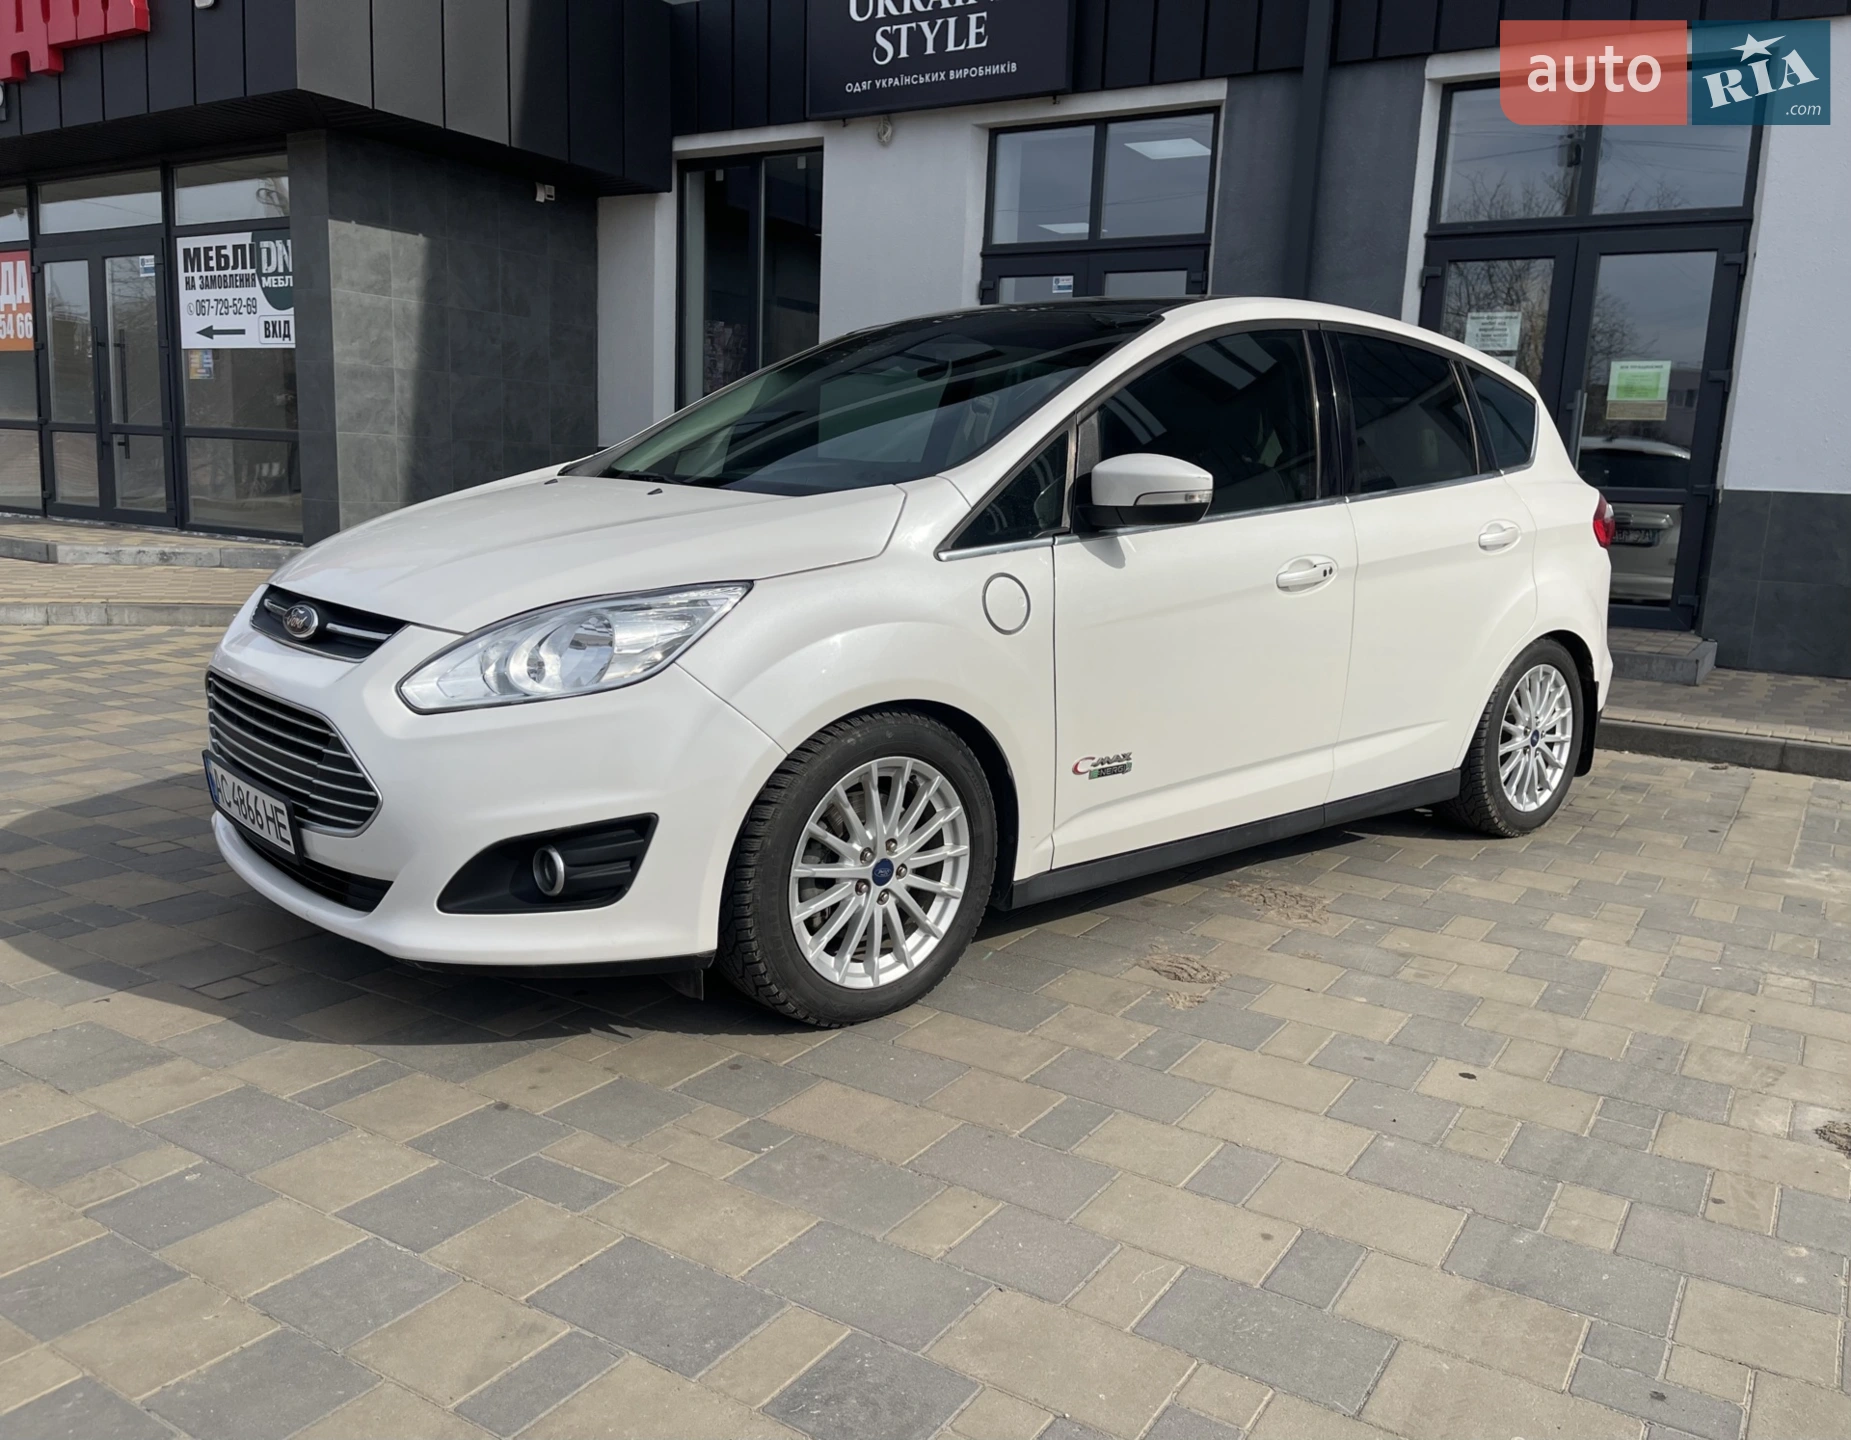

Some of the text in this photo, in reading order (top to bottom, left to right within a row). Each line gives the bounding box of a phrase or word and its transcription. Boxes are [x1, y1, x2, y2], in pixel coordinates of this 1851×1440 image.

[873, 12, 988, 65] STYLE
[845, 62, 1018, 93] ОДЯГ УКРАЇНСЬКИХ ВИРОБНИКІВ
[183, 243, 256, 273] МЕБЛІ
[185, 273, 257, 291] НА ЗАМОВЛЕННЯ
[262, 275, 293, 288] МЕБЛ
[195, 297, 258, 317] 067-729-52-69
[16, 312, 34, 339] 66
[264, 320, 292, 342] ВХІД
[232, 782, 264, 830] 4866
[262, 799, 291, 847] HE
